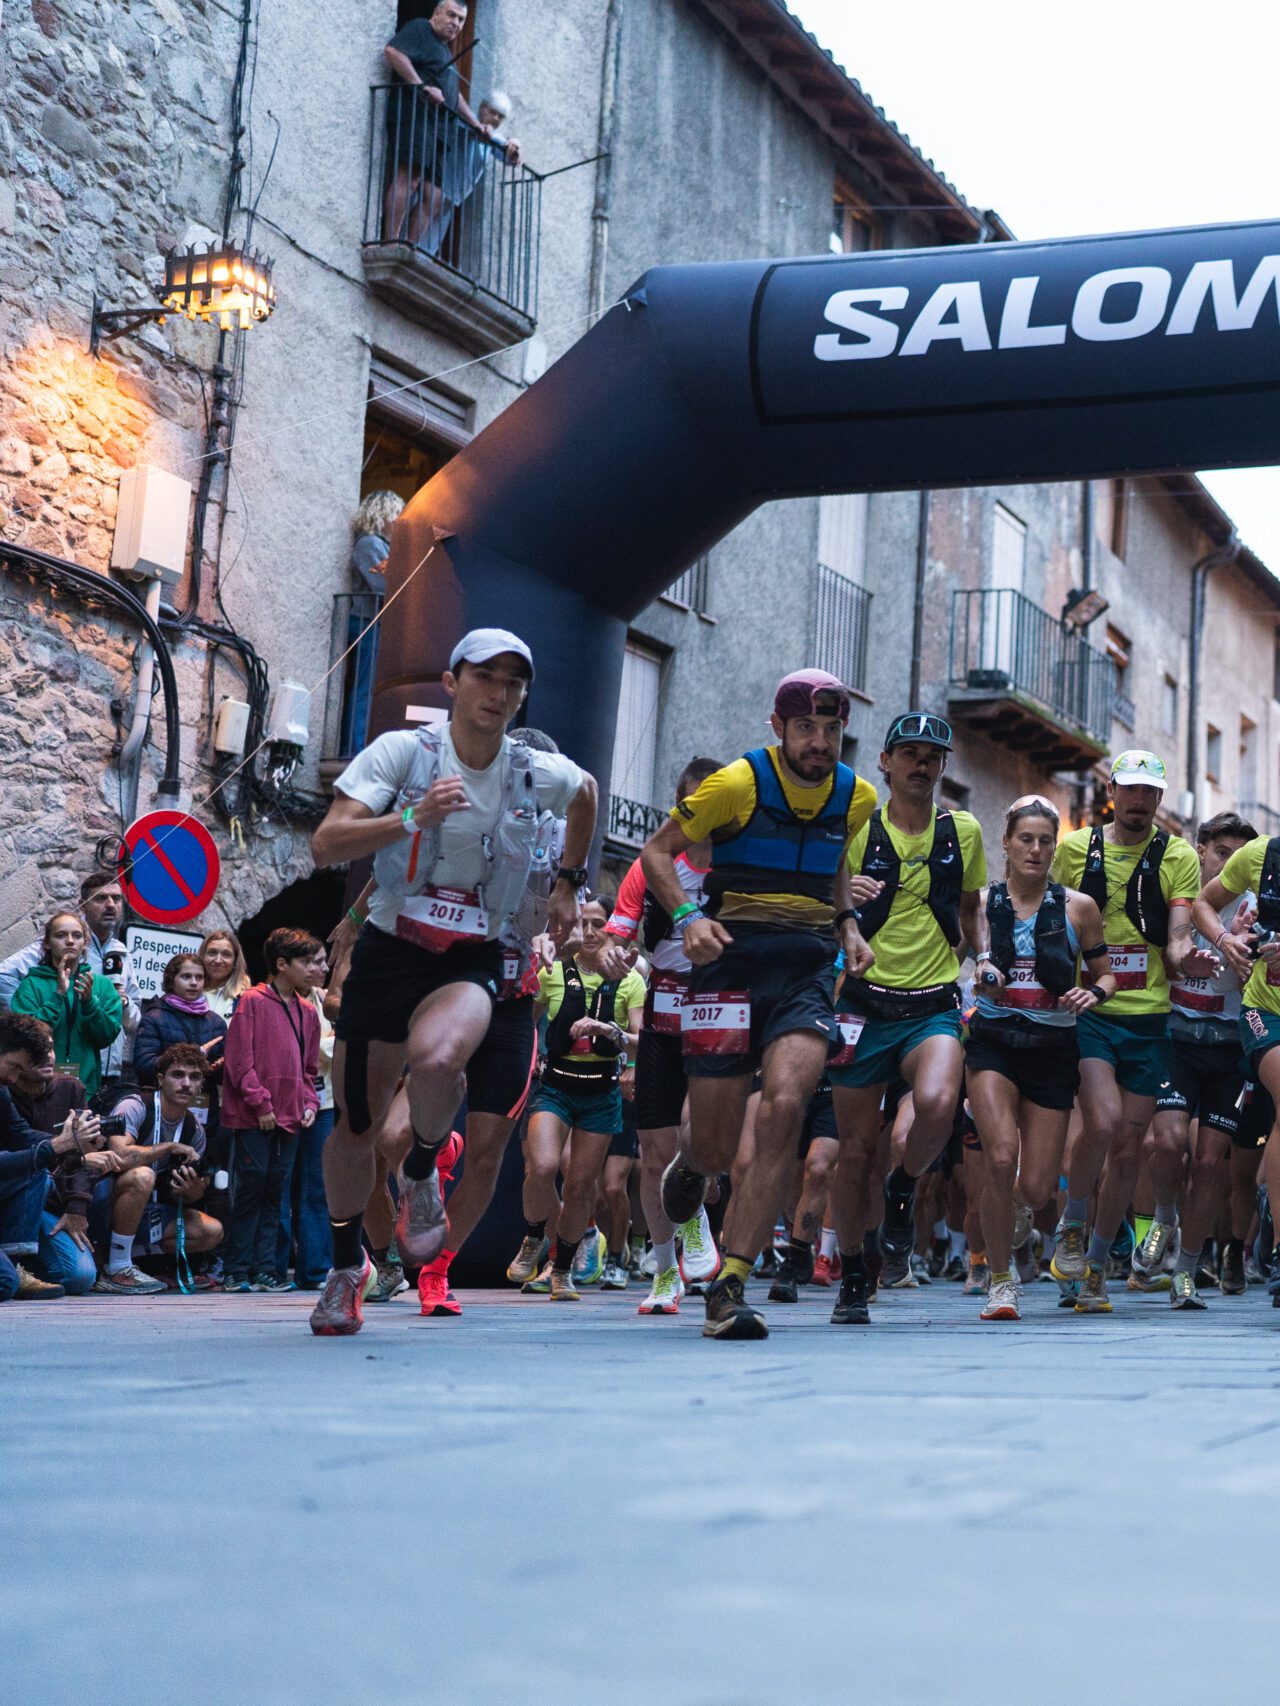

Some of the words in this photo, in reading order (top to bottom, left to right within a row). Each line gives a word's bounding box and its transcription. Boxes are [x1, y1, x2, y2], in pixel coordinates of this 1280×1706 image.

[428, 903, 466, 923] 2015
[105, 958, 114, 970] 3
[145, 958, 167, 973] des
[136, 975, 157, 991] els
[691, 1007, 723, 1021] 2017
